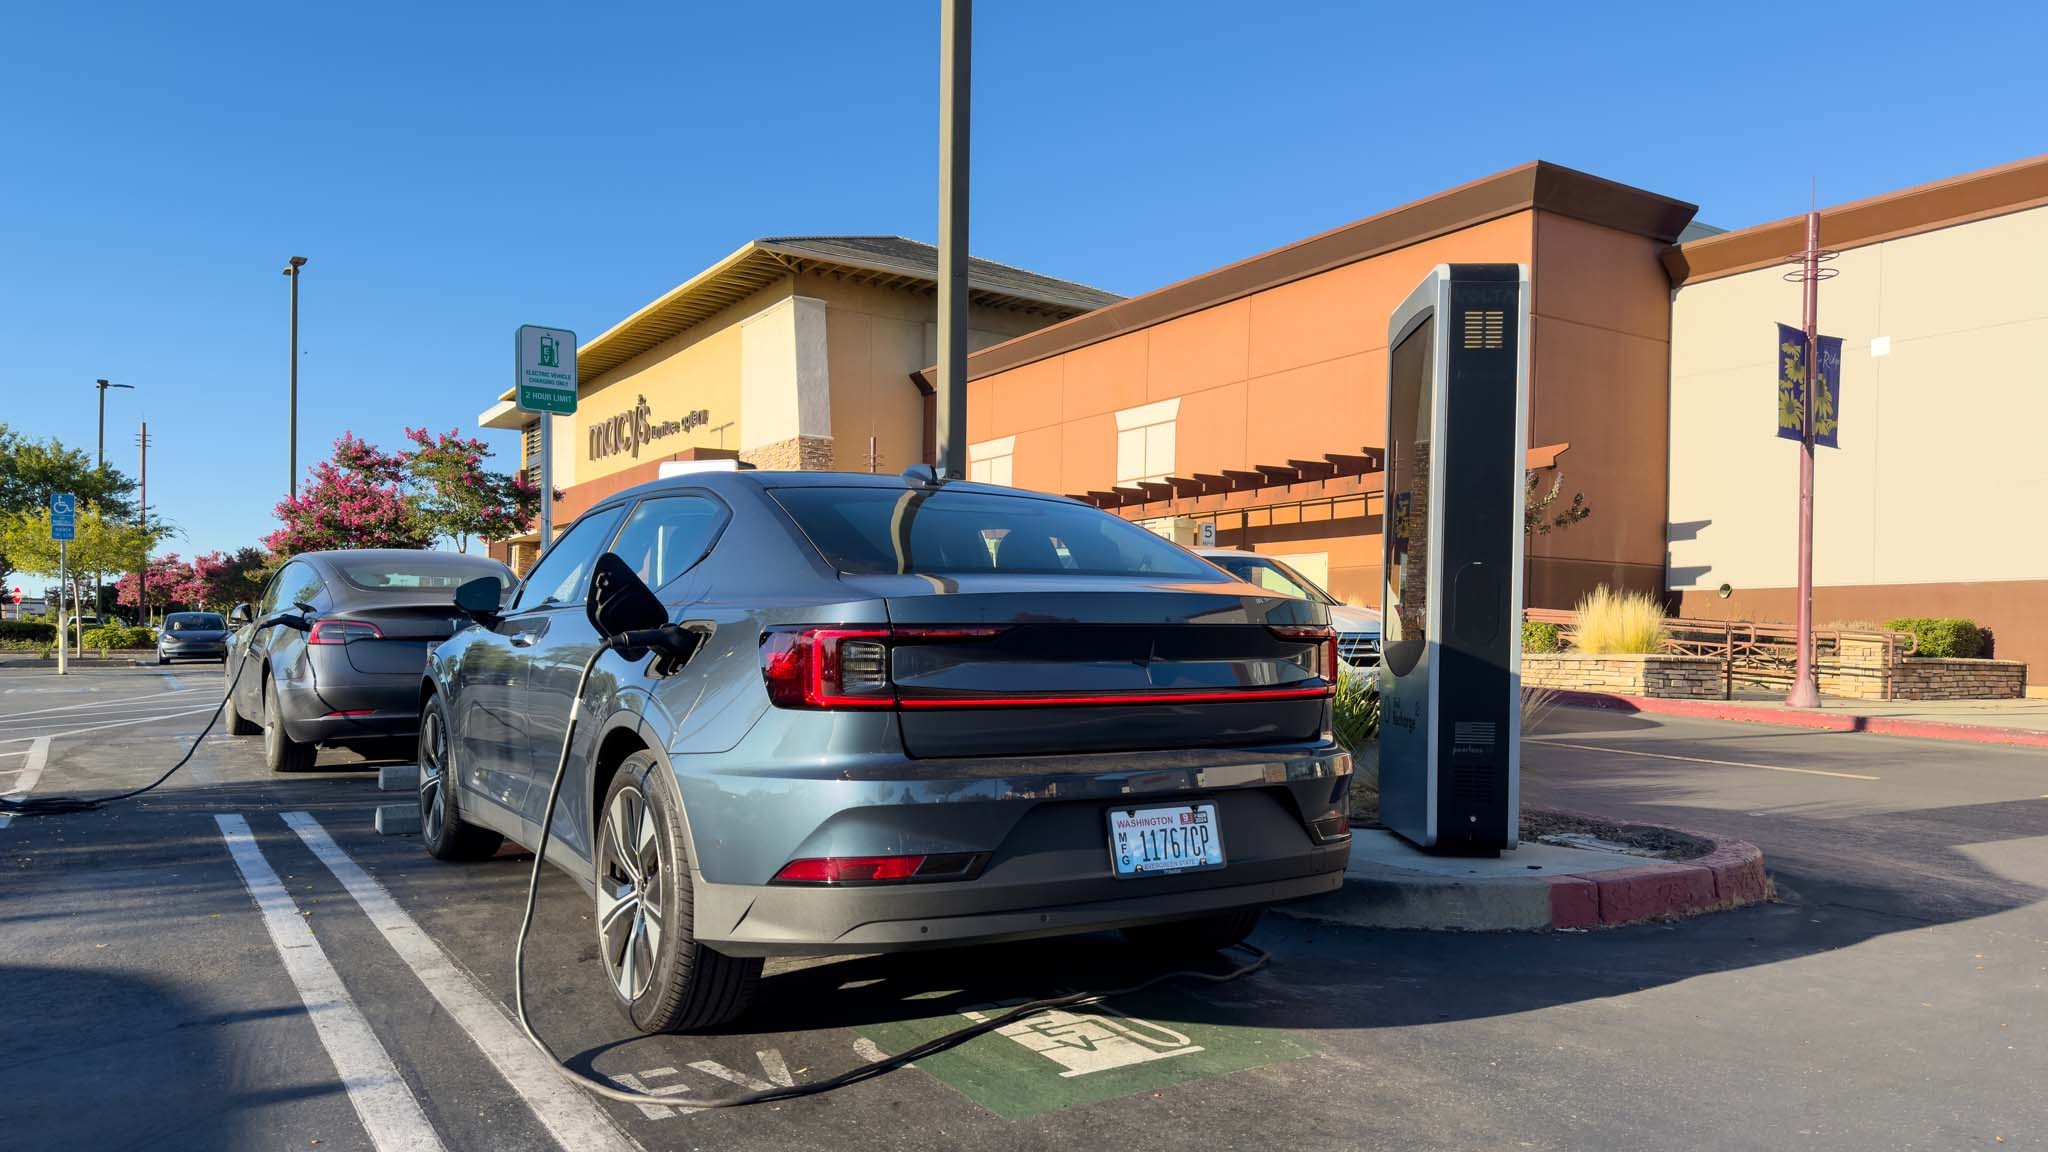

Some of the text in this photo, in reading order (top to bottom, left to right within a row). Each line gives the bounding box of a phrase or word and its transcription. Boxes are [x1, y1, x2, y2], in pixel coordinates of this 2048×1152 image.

[526, 369, 571, 380] ELECTRIC VEHICLE
[529, 377, 555, 385] CHARGING
[525, 391, 572, 404] 2 HOUR LIMIT
[1205, 525, 1212, 538] 5
[1118, 817, 1173, 828] WASHINGTON
[1140, 825, 1209, 862] 11767CP
